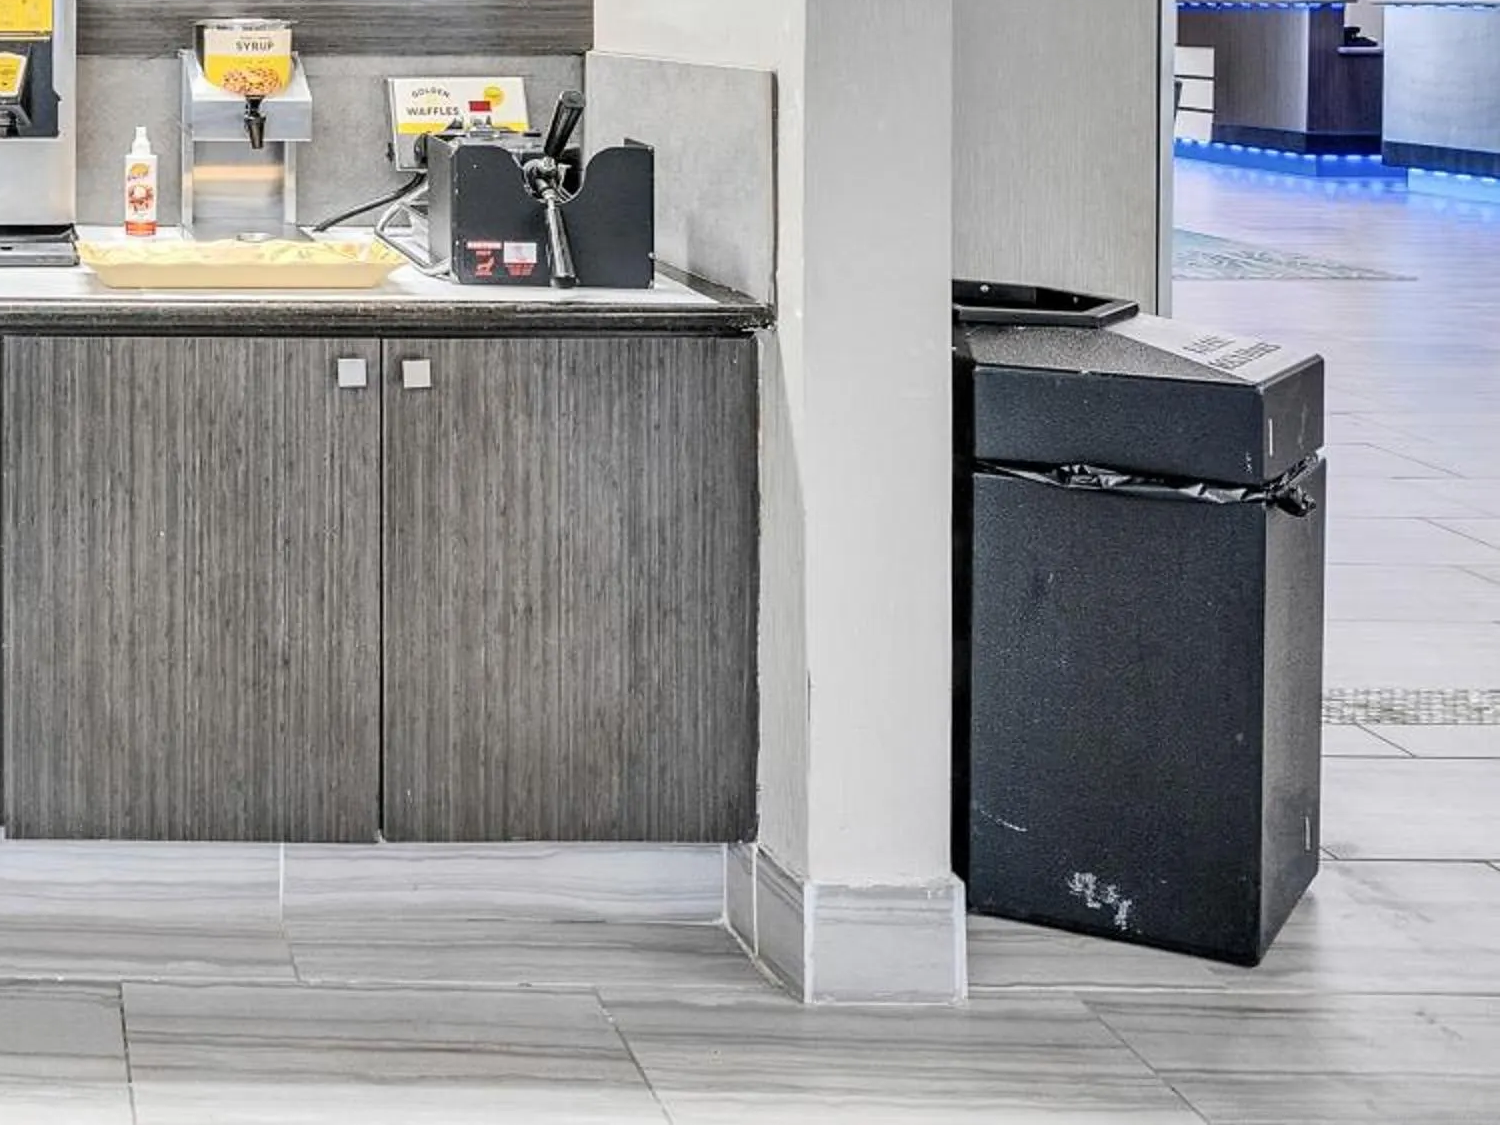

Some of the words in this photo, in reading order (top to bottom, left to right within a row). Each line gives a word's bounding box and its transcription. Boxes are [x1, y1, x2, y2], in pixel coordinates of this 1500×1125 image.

[235, 40, 275, 52] SYRUP
[411, 86, 451, 98] GOLDEN
[406, 106, 460, 116] WAFFLES
